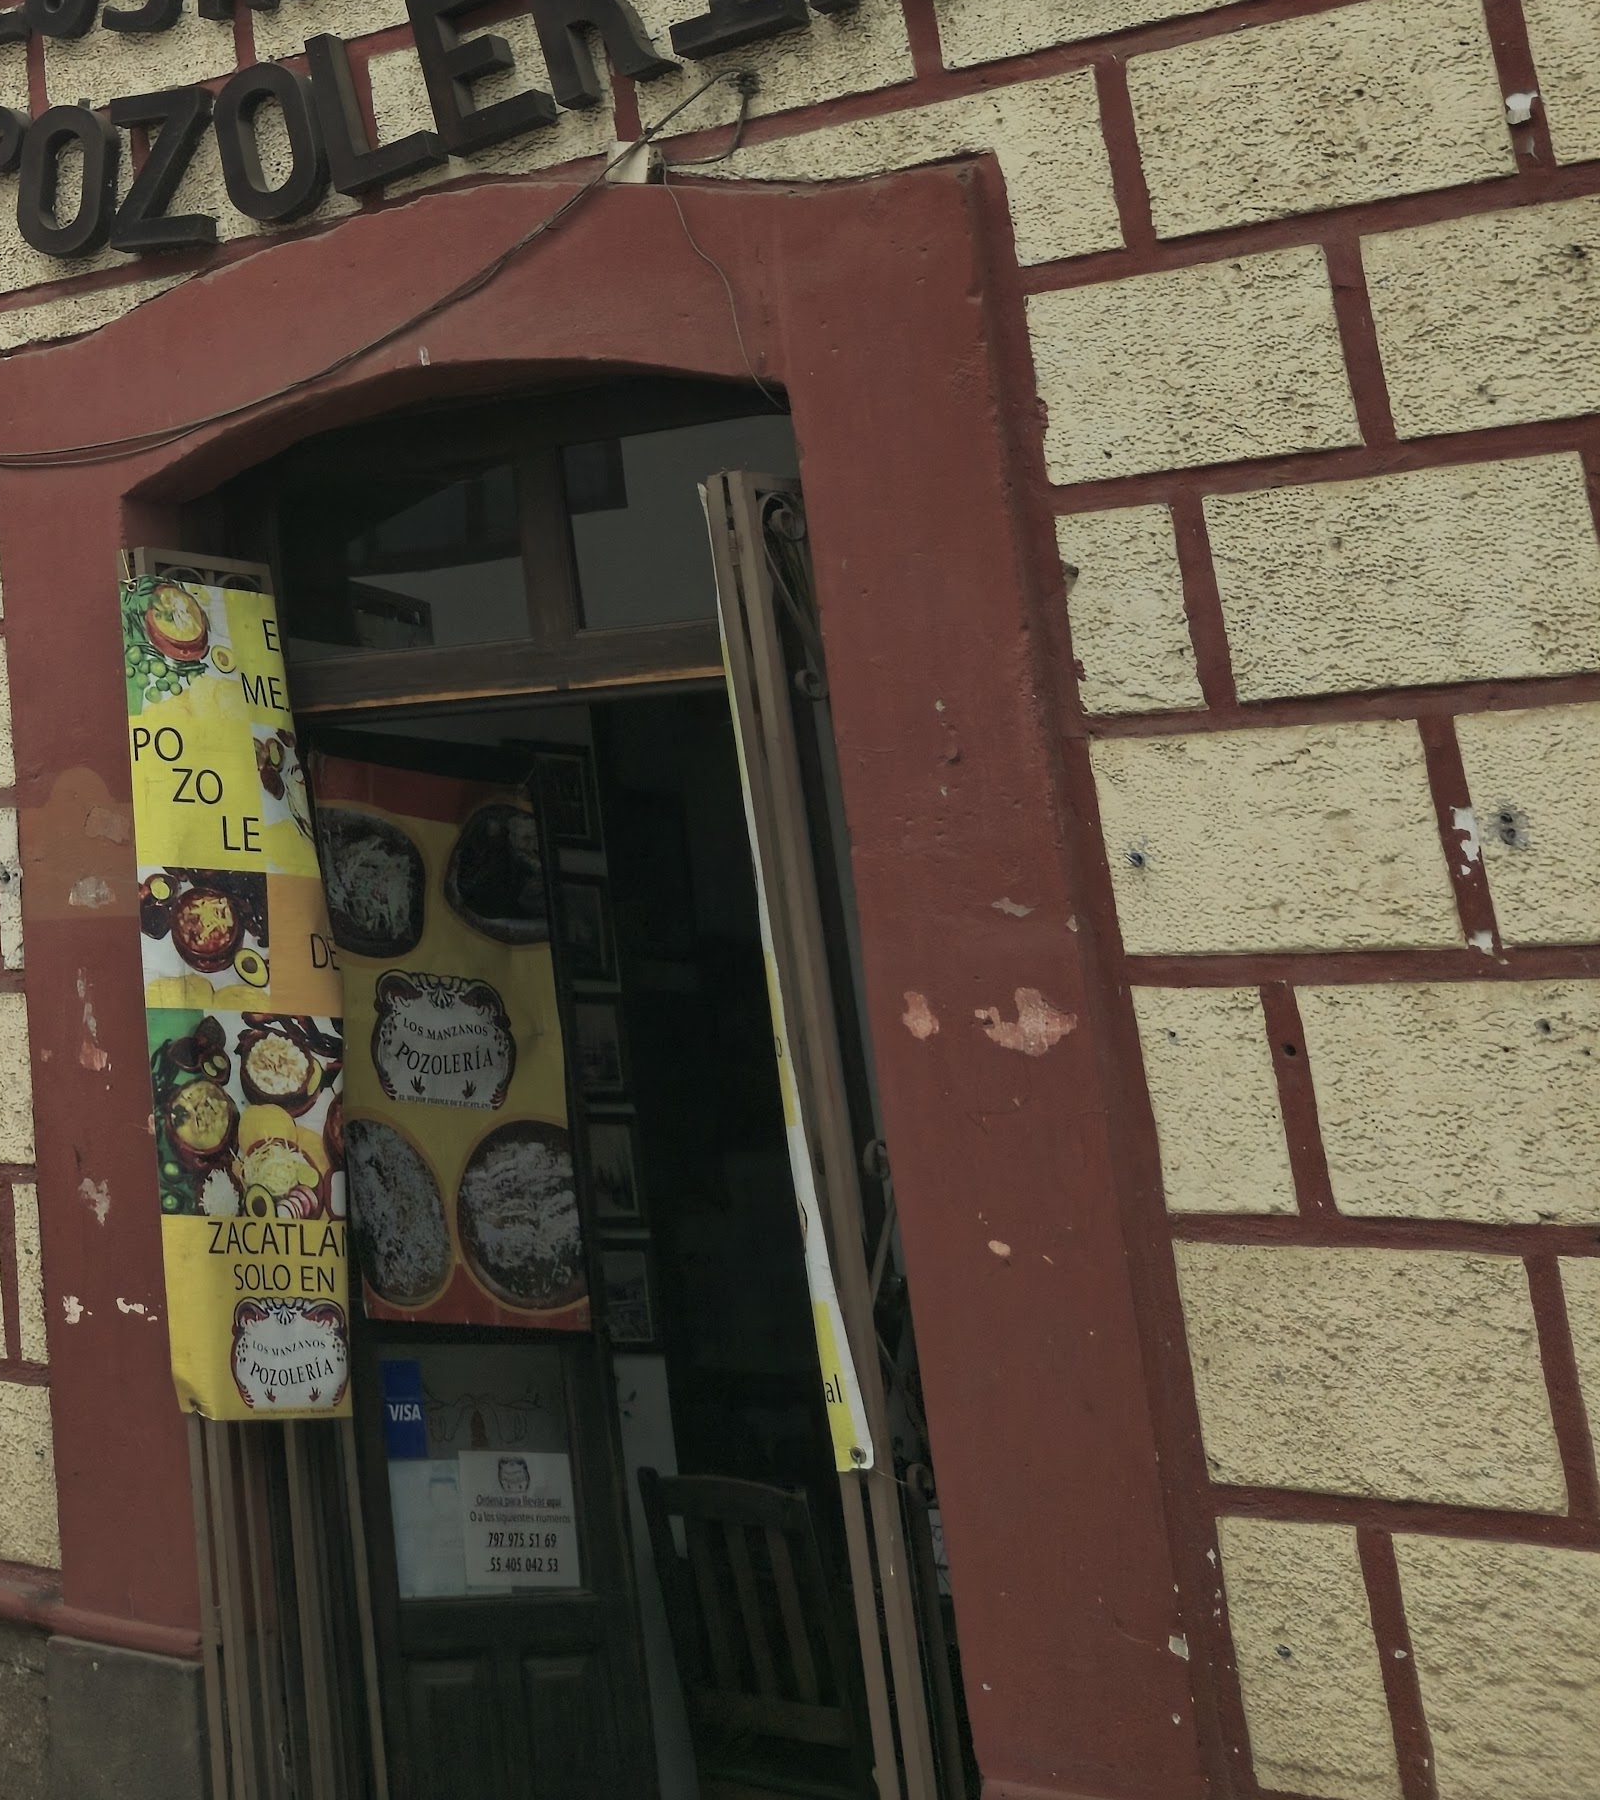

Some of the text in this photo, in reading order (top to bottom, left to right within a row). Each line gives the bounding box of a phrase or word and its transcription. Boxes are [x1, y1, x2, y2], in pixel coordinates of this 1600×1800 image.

[132, 727, 184, 762] PO
[172, 768, 223, 804] ZO
[222, 816, 262, 852] LE
[403, 1018, 488, 1041] LOS MANZANOS
[395, 1041, 494, 1075] POZOLERÍA
[233, 1264, 335, 1293] SOLO EN
[252, 1339, 326, 1357] LOS MANZANOS
[250, 1357, 334, 1387] POZOLERÍA
[389, 1403, 422, 1422] VISA
[488, 1532, 557, 1547] 797 975 51 69
[490, 1558, 558, 1572] 55 405 042 53
